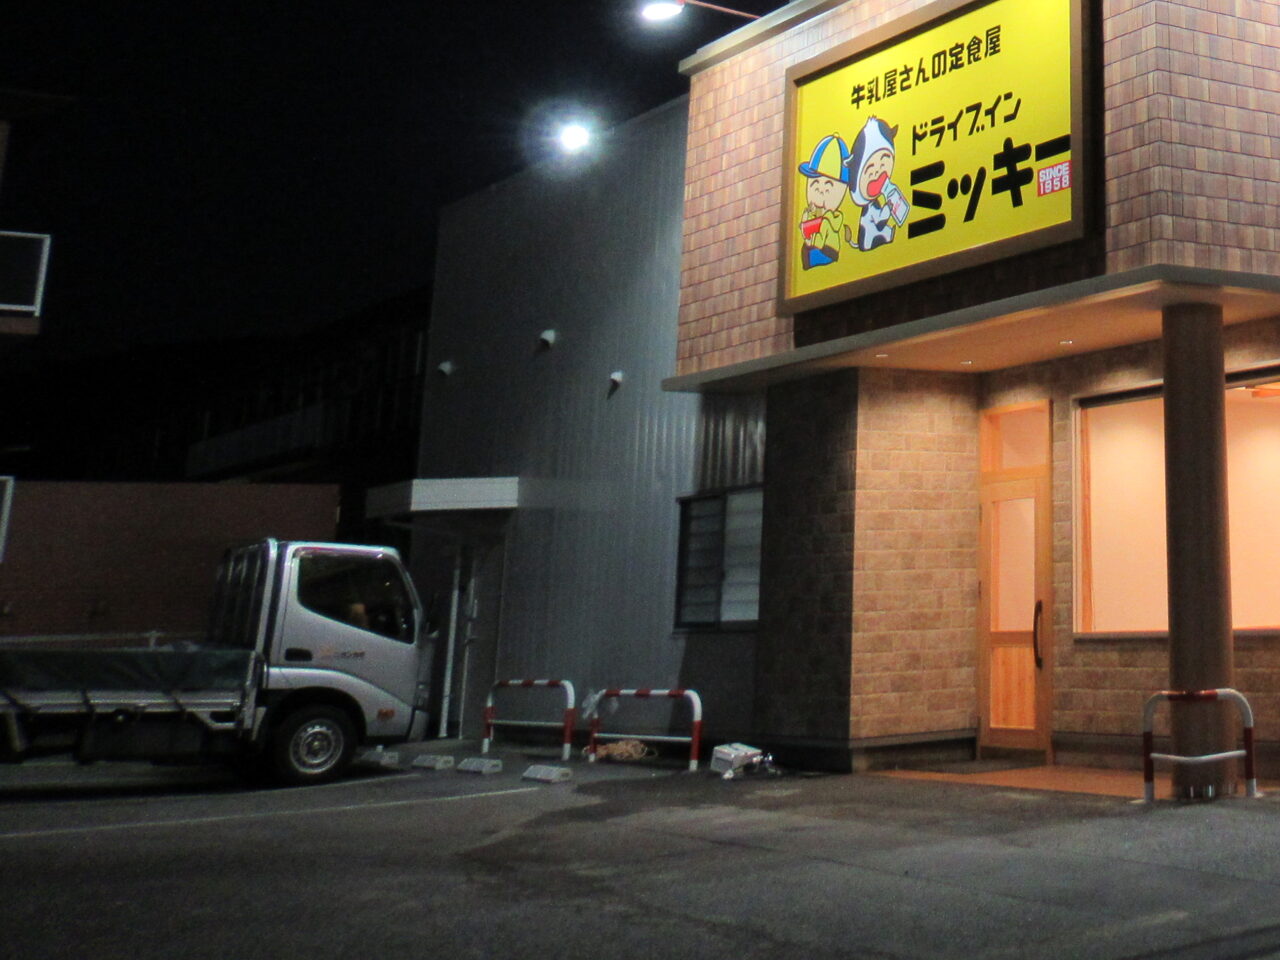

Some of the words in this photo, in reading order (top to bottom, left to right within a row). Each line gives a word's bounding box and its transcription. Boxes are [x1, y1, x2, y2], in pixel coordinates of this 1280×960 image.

[850, 25, 1002, 110] 牛乳屋さんの定食屋
[911, 91, 1022, 156] ドライブイン
[908, 134, 1072, 239] ミッキー
[1039, 161, 1070, 182] SINCE
[1040, 174, 1070, 195] 1958
